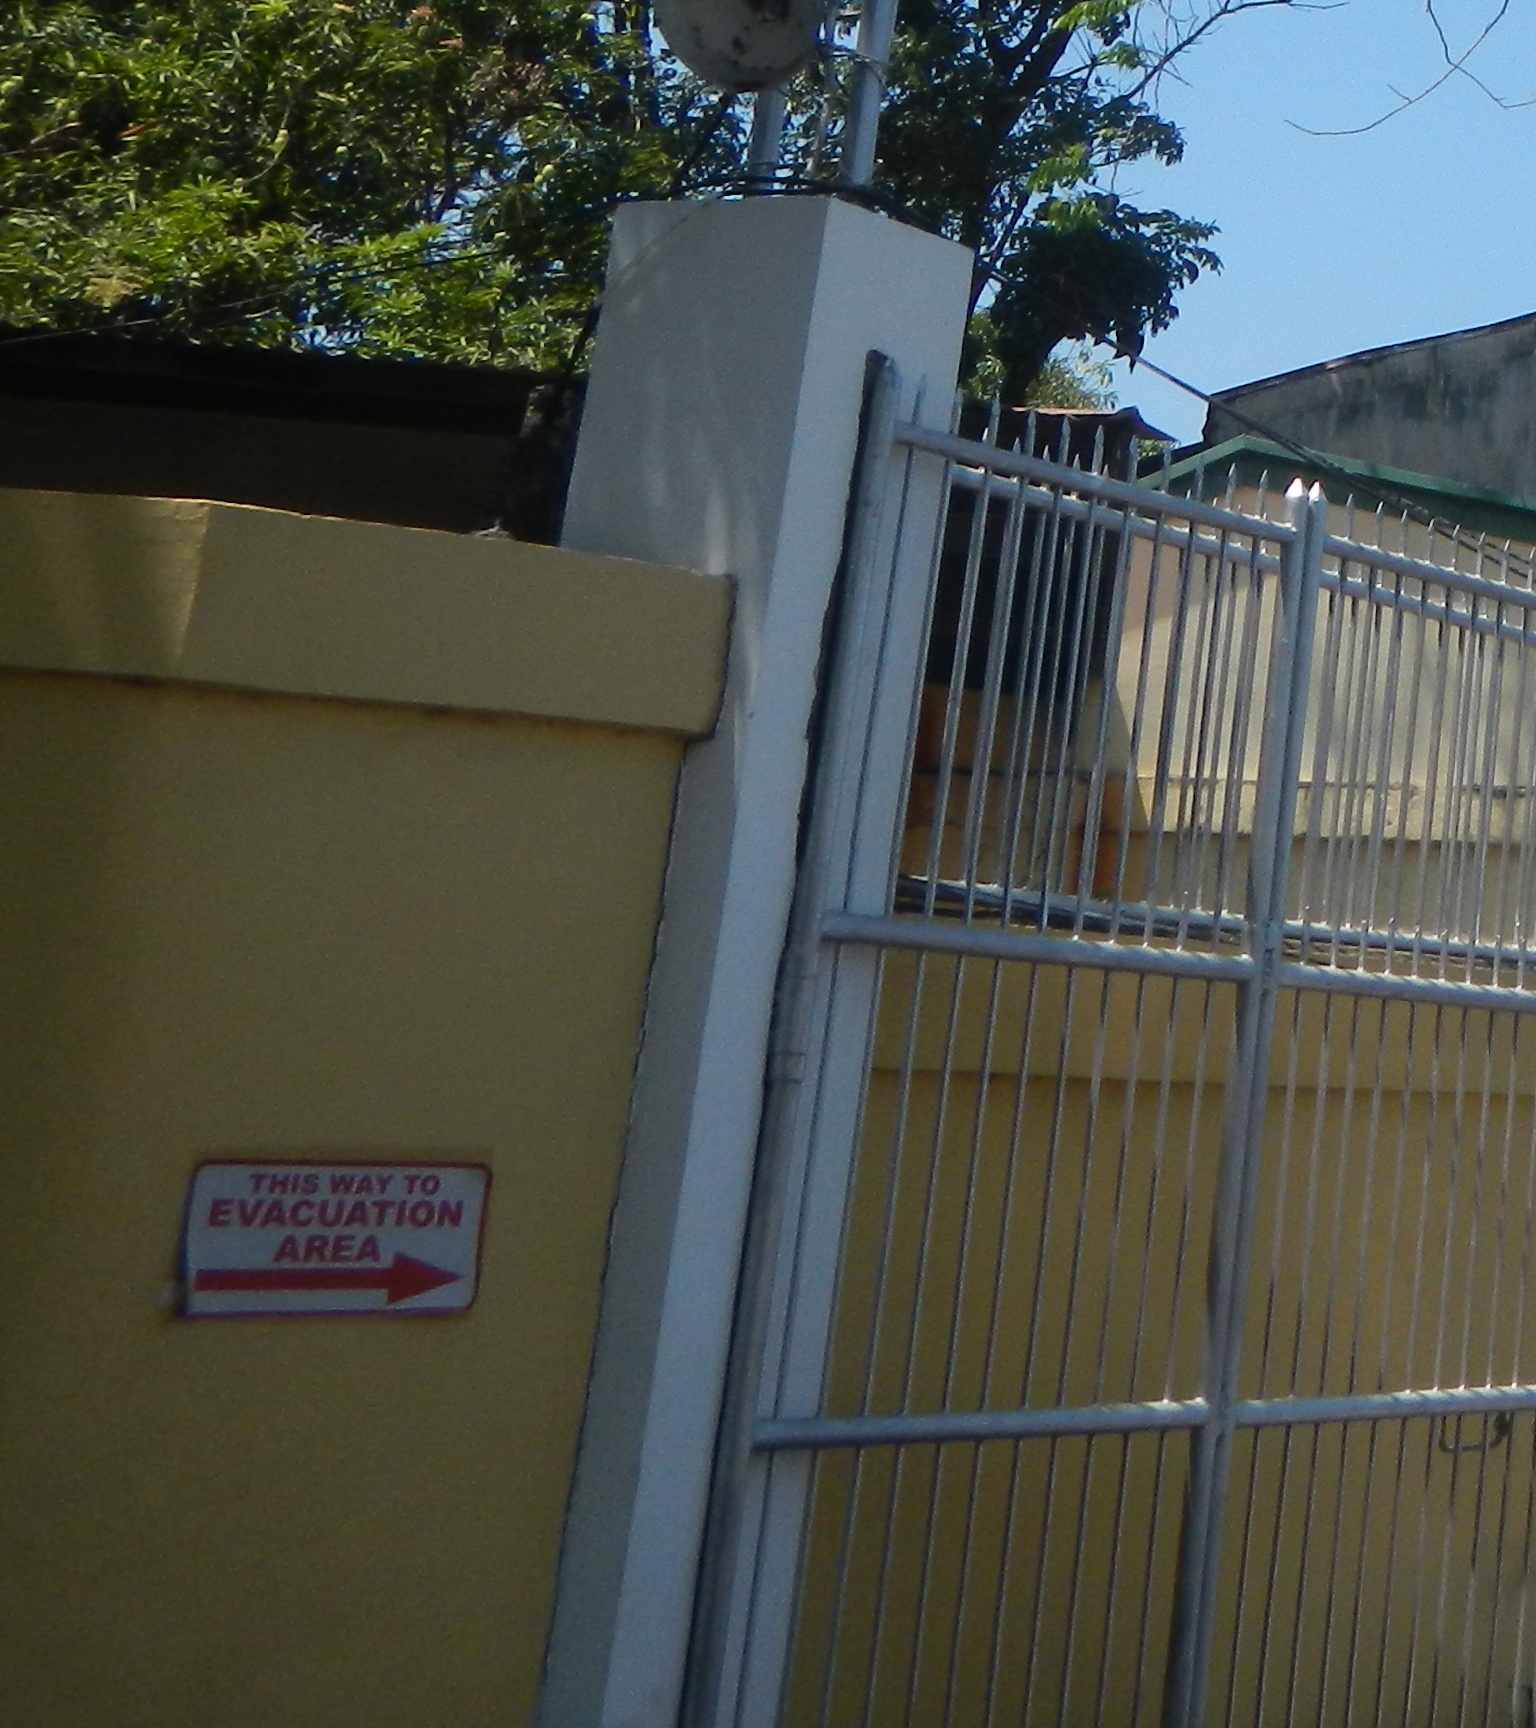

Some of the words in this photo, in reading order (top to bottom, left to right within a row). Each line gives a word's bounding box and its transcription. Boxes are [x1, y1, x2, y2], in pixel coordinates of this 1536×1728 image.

[251, 1174, 320, 1195] THIS
[330, 1174, 394, 1195] WAY
[404, 1175, 440, 1196] TO
[208, 1199, 464, 1228] EVACUATION
[273, 1235, 382, 1264] AREA
